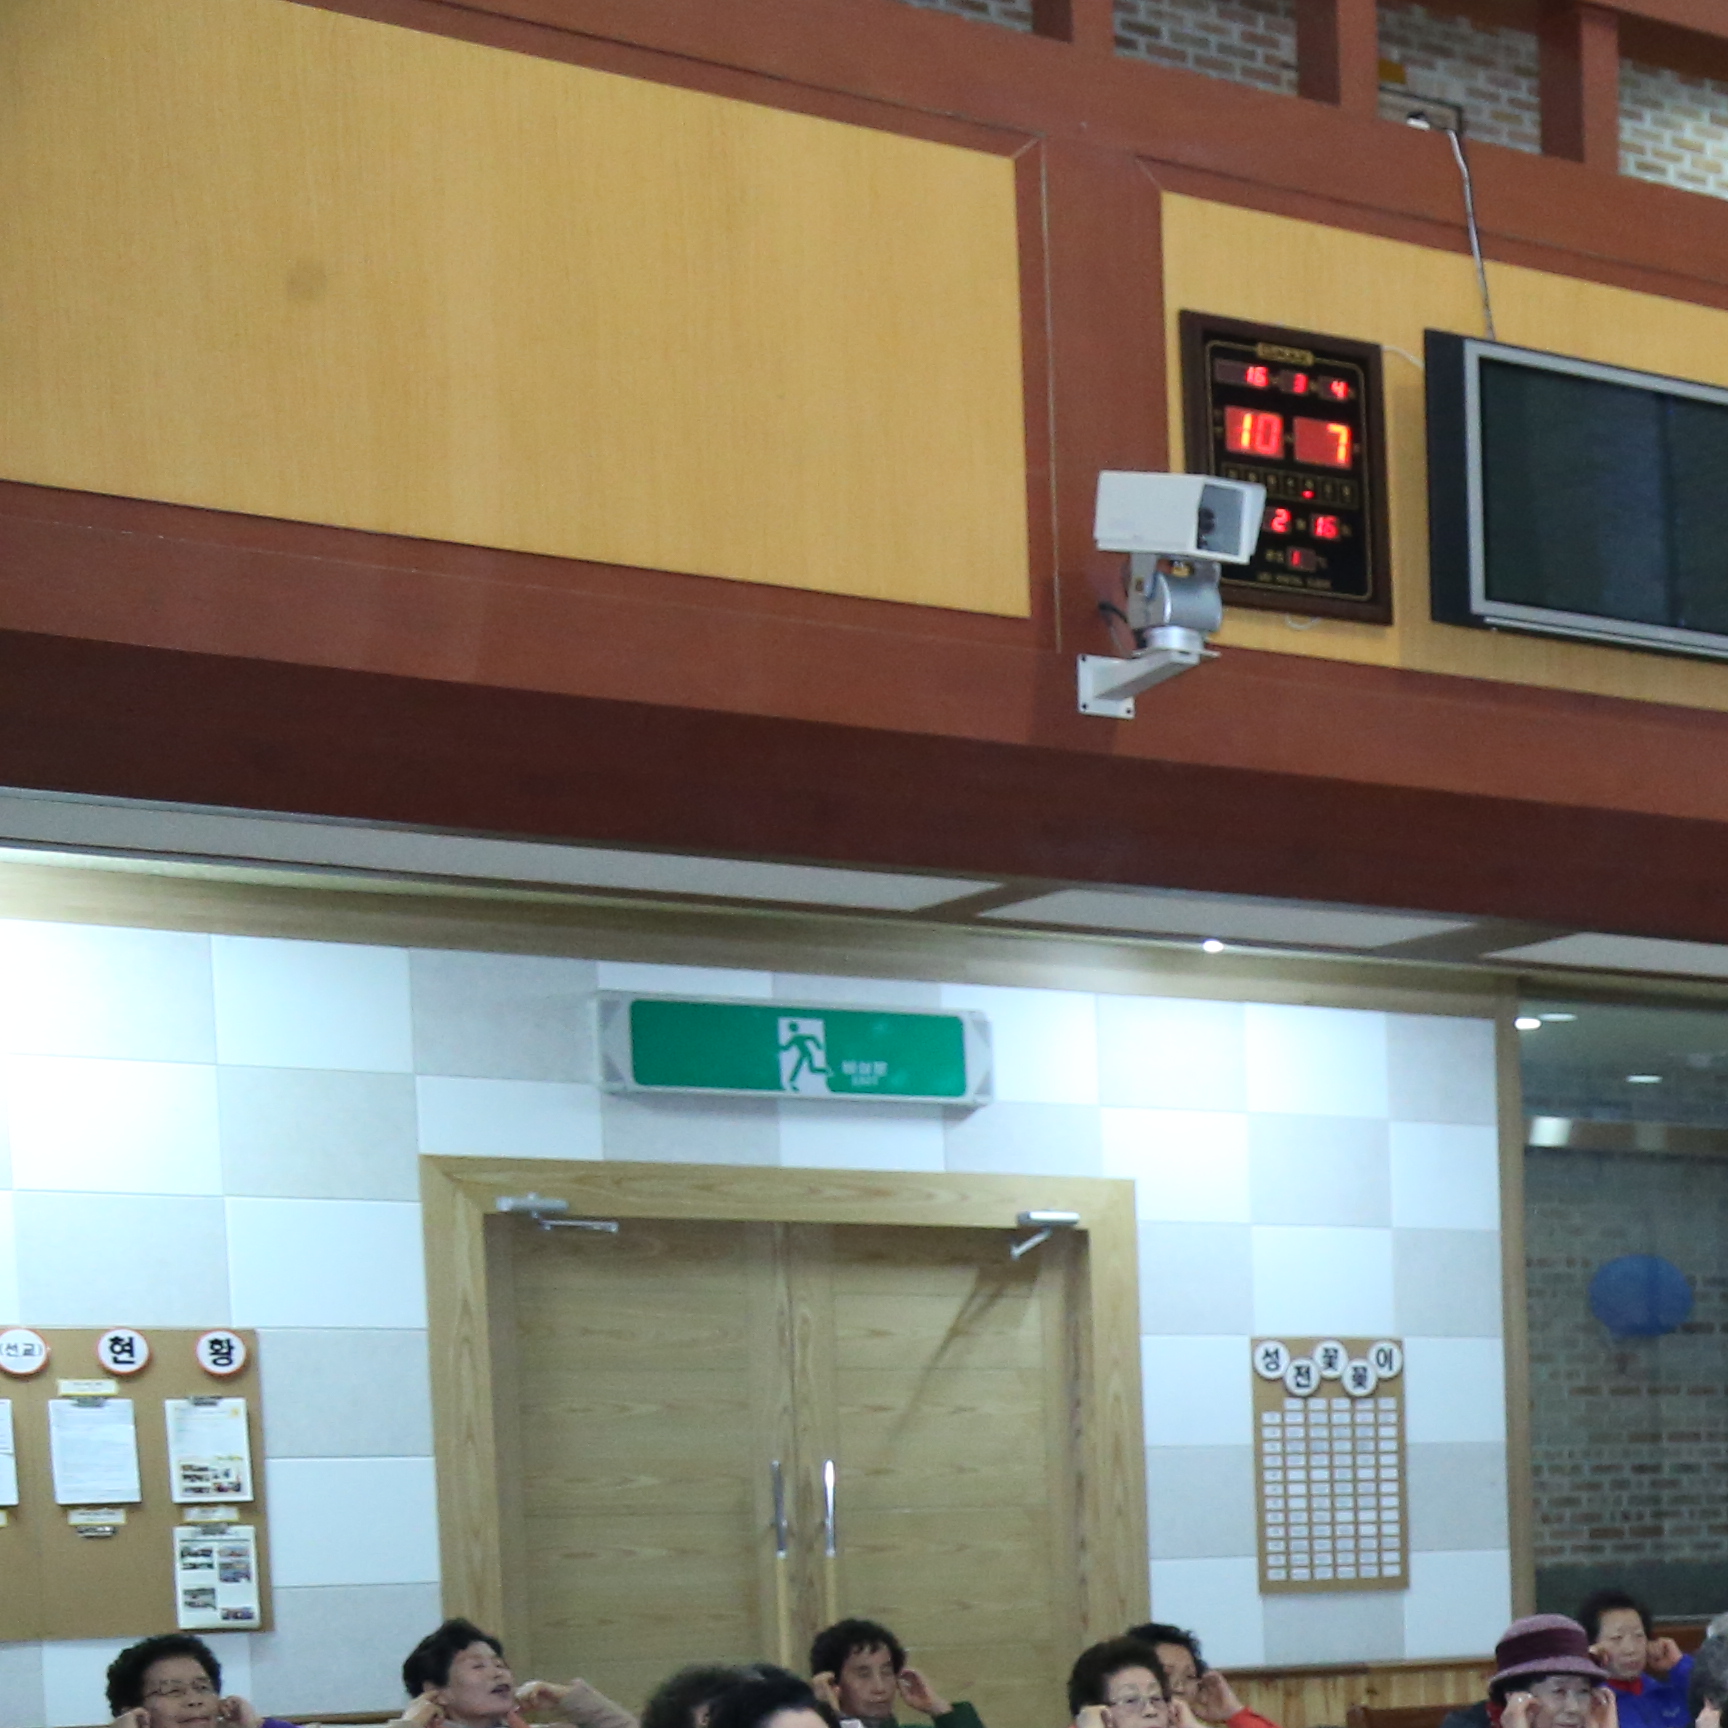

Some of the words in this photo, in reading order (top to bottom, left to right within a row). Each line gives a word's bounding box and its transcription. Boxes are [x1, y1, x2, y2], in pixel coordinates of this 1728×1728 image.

[1330, 380, 1350, 400] 4
[1241, 412, 1284, 454] 10
[1326, 422, 1352, 465] 7
[1270, 507, 1291, 533] 2
[109, 1335, 135, 1366] 현
[209, 1338, 235, 1367] 황
